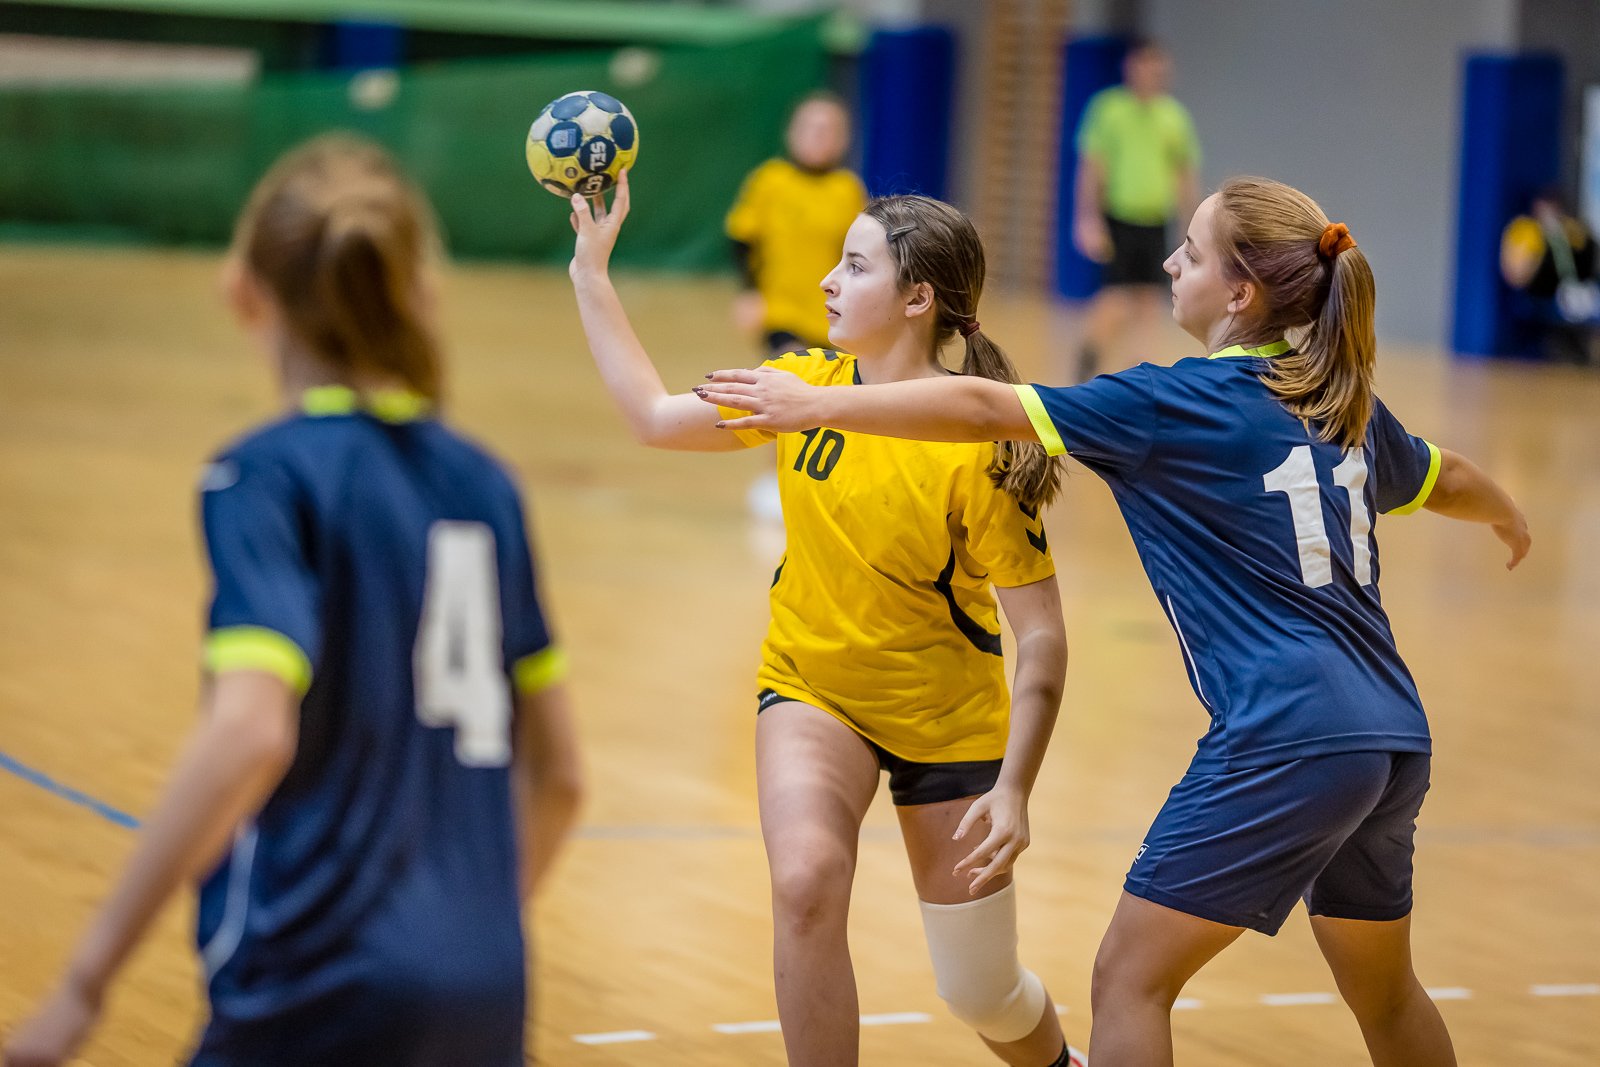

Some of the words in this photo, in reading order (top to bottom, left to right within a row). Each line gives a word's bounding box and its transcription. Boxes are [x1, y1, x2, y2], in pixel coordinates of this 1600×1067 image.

[793, 426, 845, 481] 10
[1263, 445, 1372, 588] 11
[412, 521, 512, 767] 4
